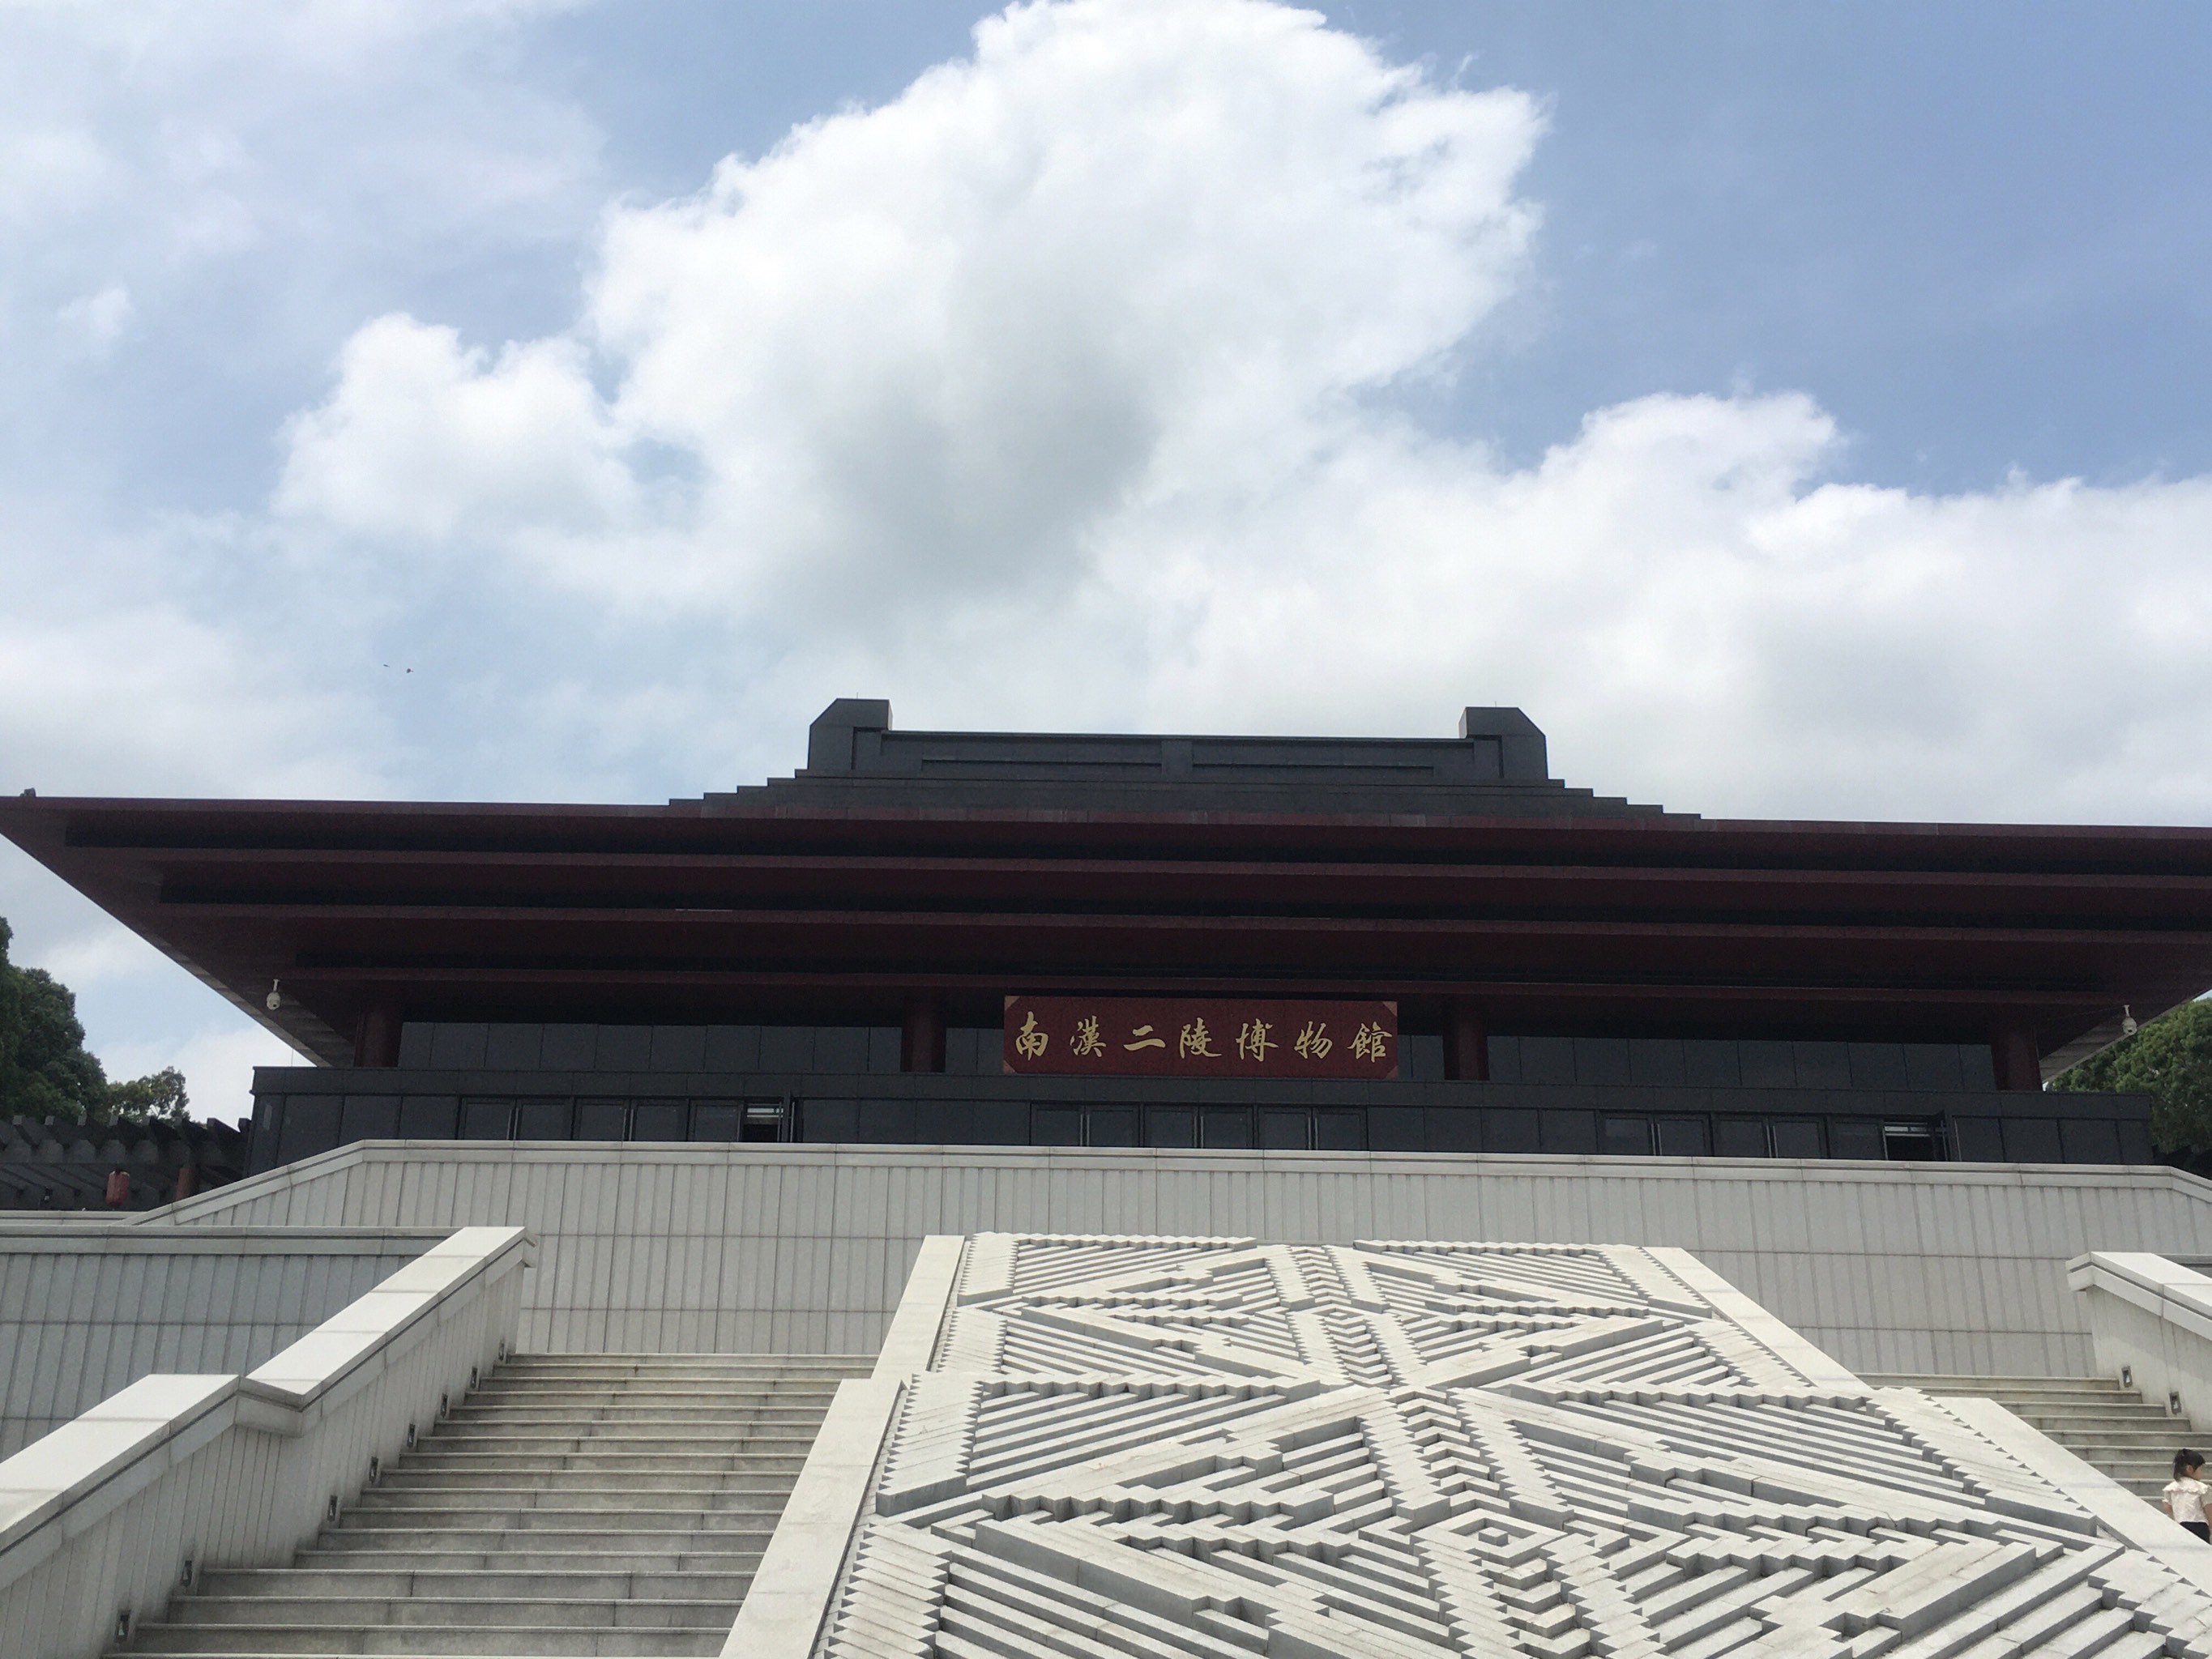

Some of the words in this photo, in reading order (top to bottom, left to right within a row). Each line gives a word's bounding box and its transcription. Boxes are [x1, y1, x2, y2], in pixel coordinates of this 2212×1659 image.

[1014, 1011, 1392, 1063] 南漢二陵博物館
